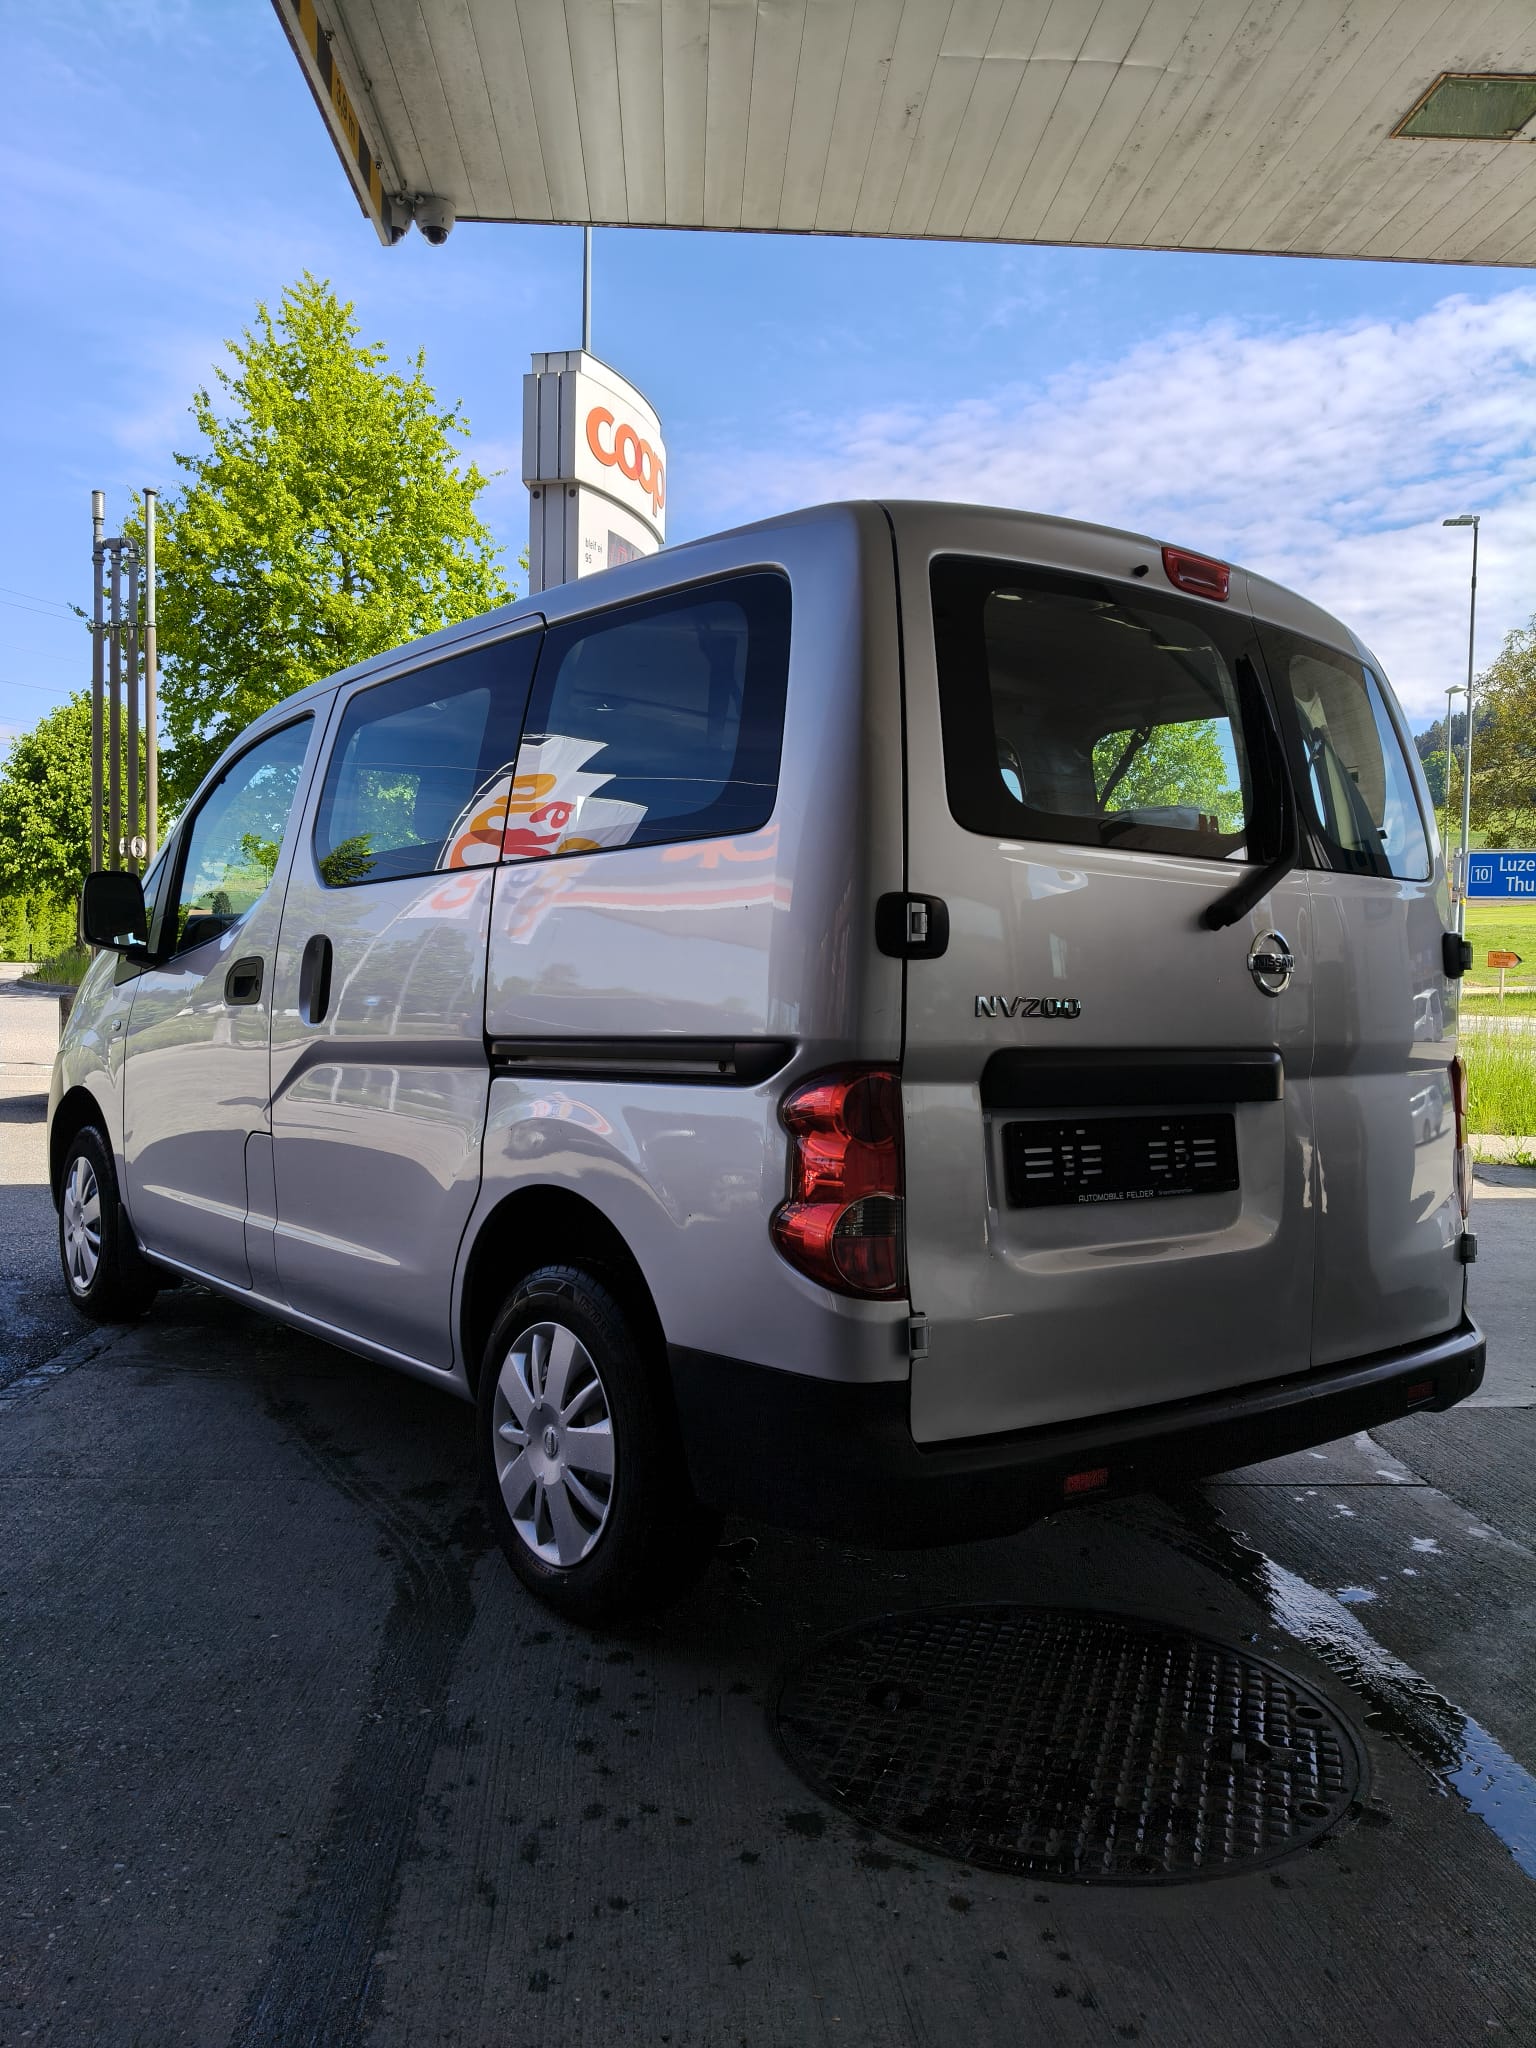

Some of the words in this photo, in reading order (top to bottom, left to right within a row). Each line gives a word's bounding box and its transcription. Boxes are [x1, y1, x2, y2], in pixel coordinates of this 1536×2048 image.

[586, 406, 664, 518] coop
[584, 552, 592, 564] 95
[1475, 868, 1489, 881] 10
[1253, 955, 1293, 970] NISSAN
[974, 995, 1082, 1019] NV200
[1078, 1192, 1124, 1203] AUTOMOBILE
[1126, 1189, 1154, 1199] FELDER
